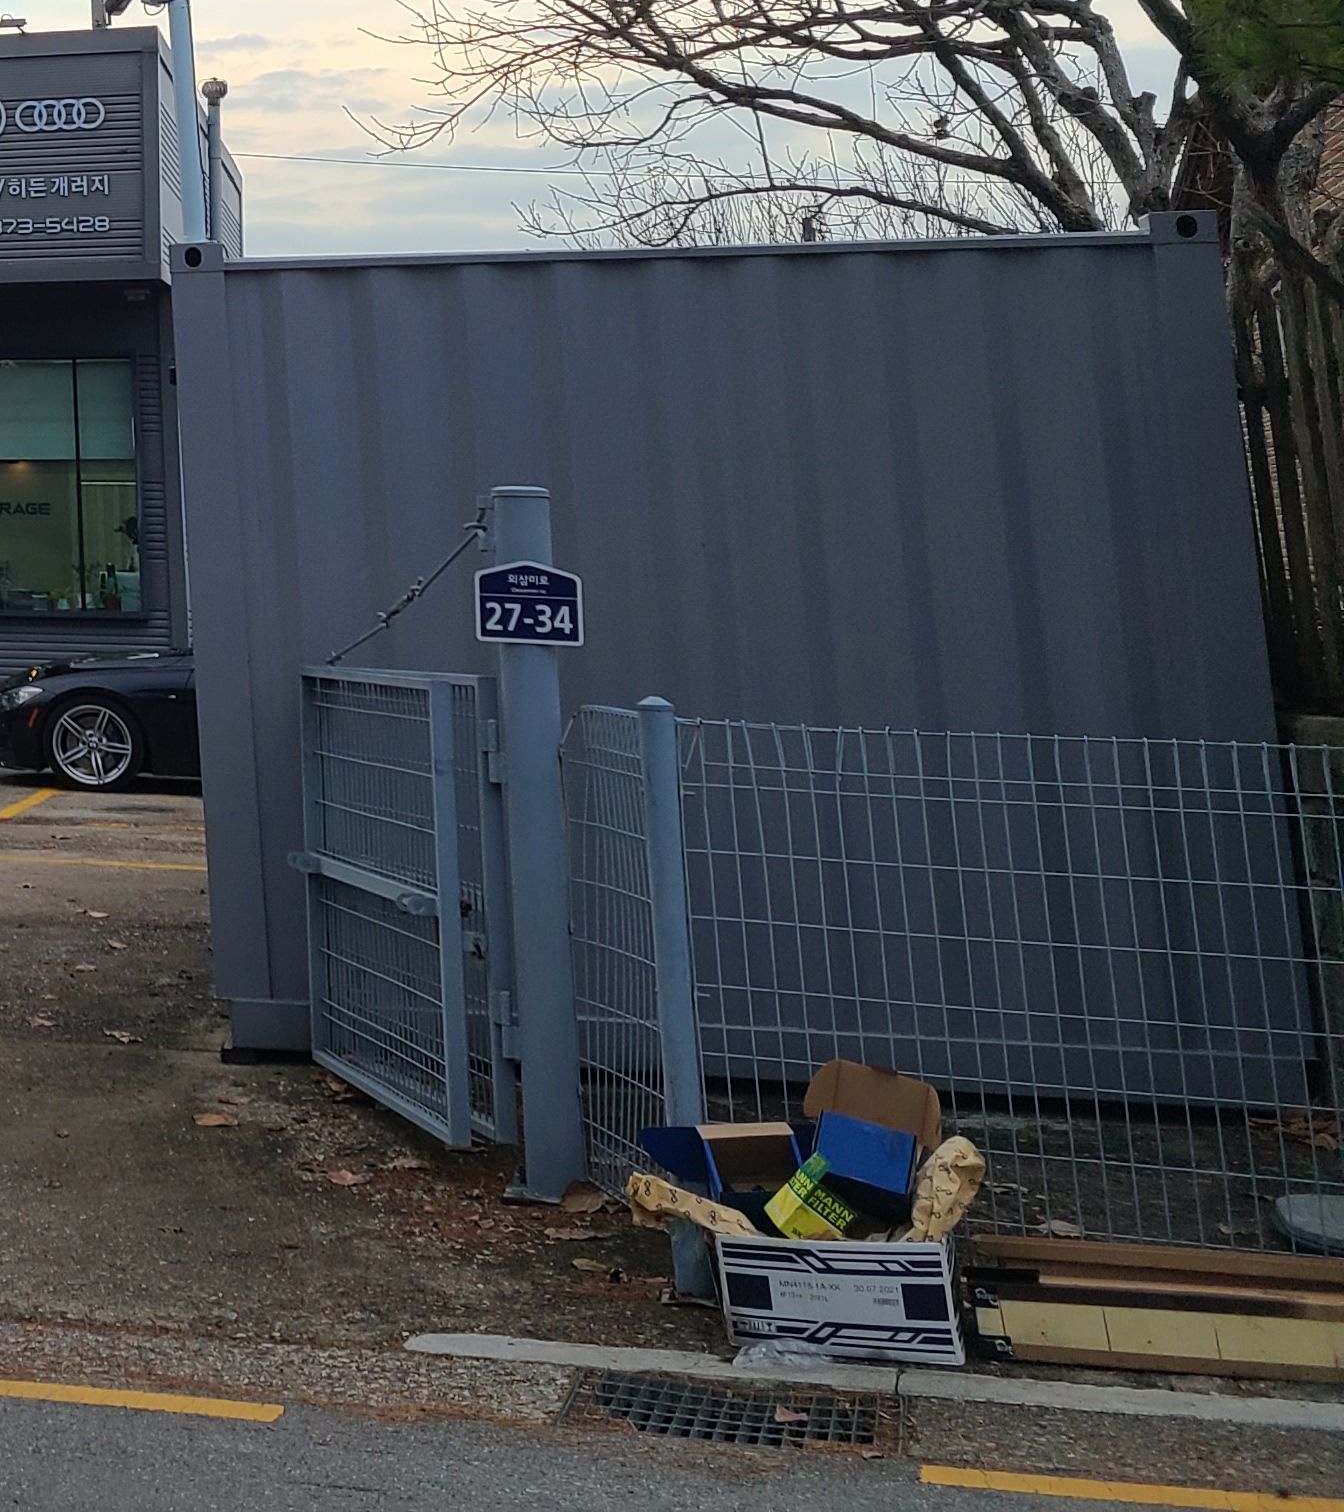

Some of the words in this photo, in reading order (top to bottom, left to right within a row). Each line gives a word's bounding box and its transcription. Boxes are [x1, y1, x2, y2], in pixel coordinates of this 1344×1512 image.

[485, 602, 573, 635] 27-34
[807, 1196, 847, 1230] FILTER
[814, 1189, 854, 1222] MANN
